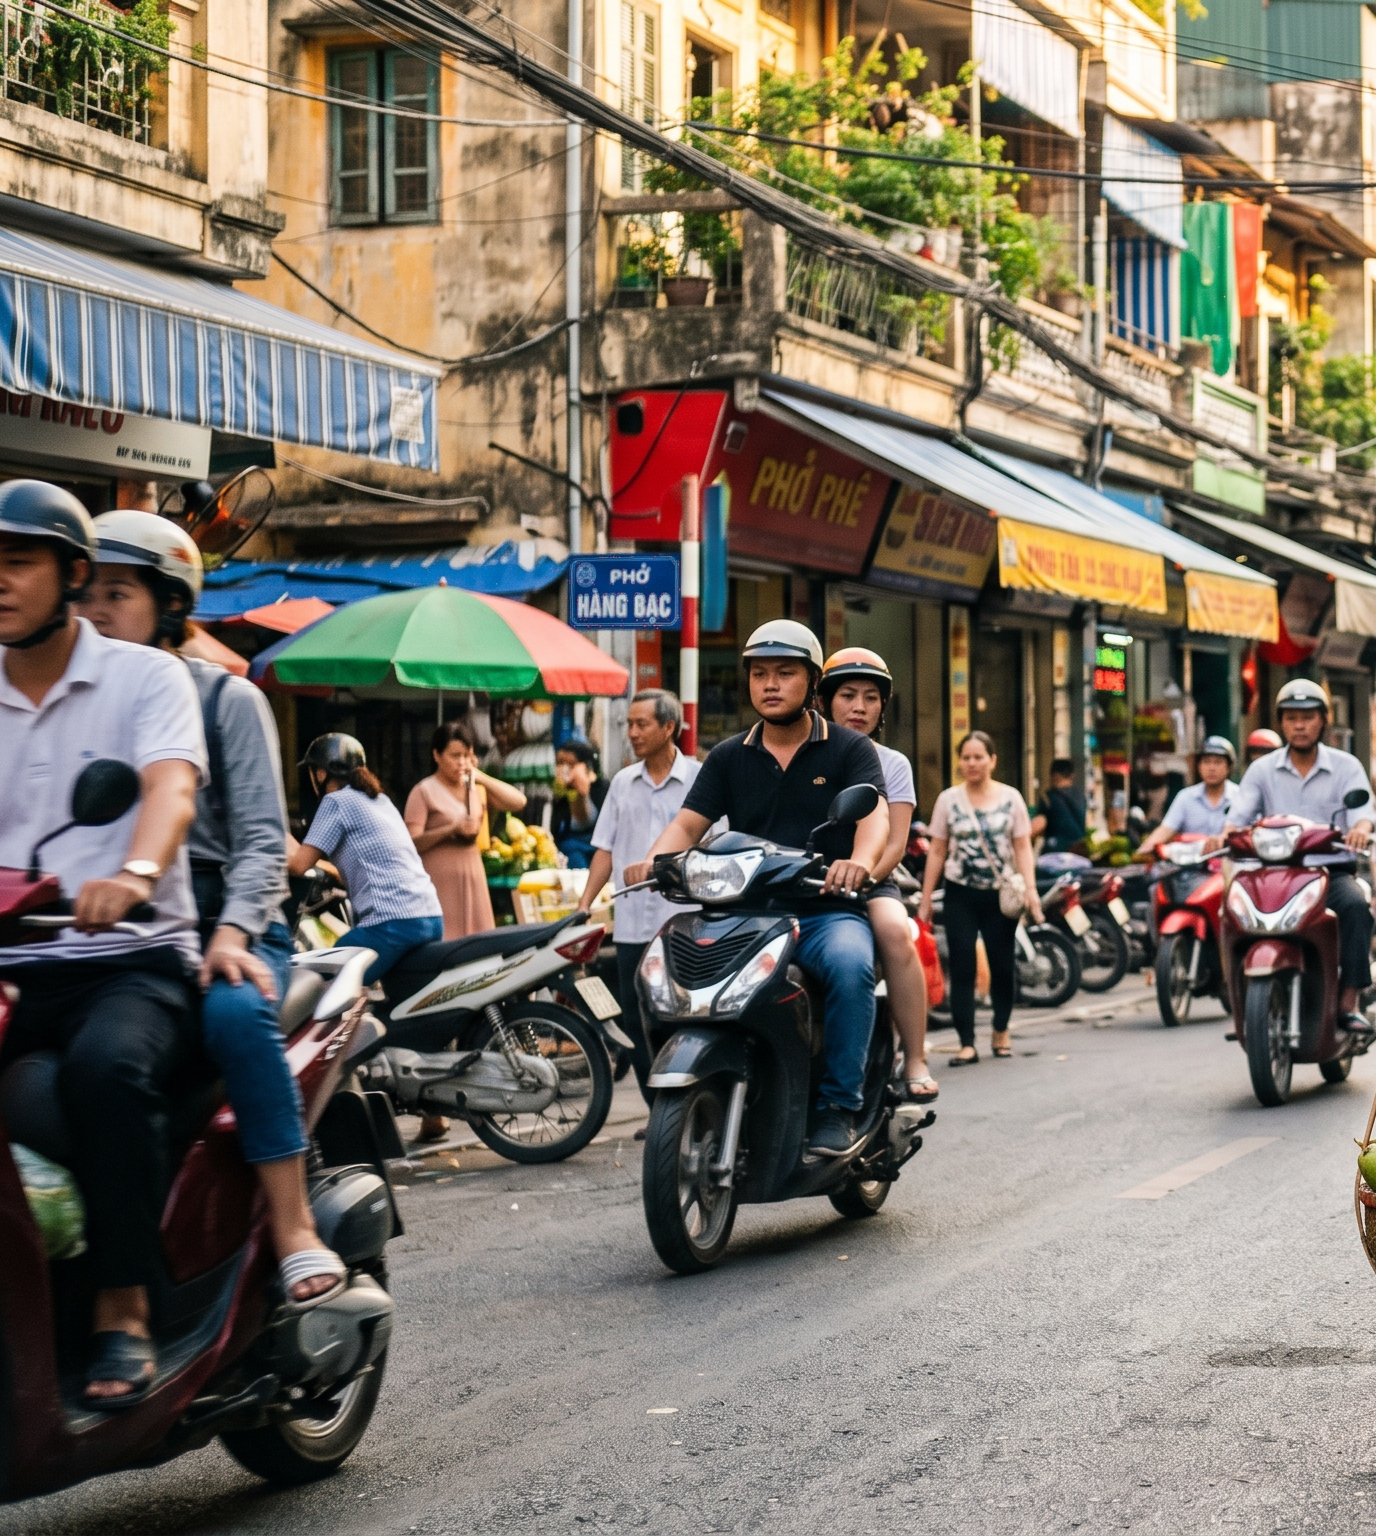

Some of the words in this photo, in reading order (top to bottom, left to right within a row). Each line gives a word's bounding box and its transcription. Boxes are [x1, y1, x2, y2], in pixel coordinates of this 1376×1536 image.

[811, 470, 872, 528] PHÊ
[610, 562, 651, 585] PHỞ
[577, 588, 628, 619] HÀNG
[634, 592, 672, 624] BẠC
